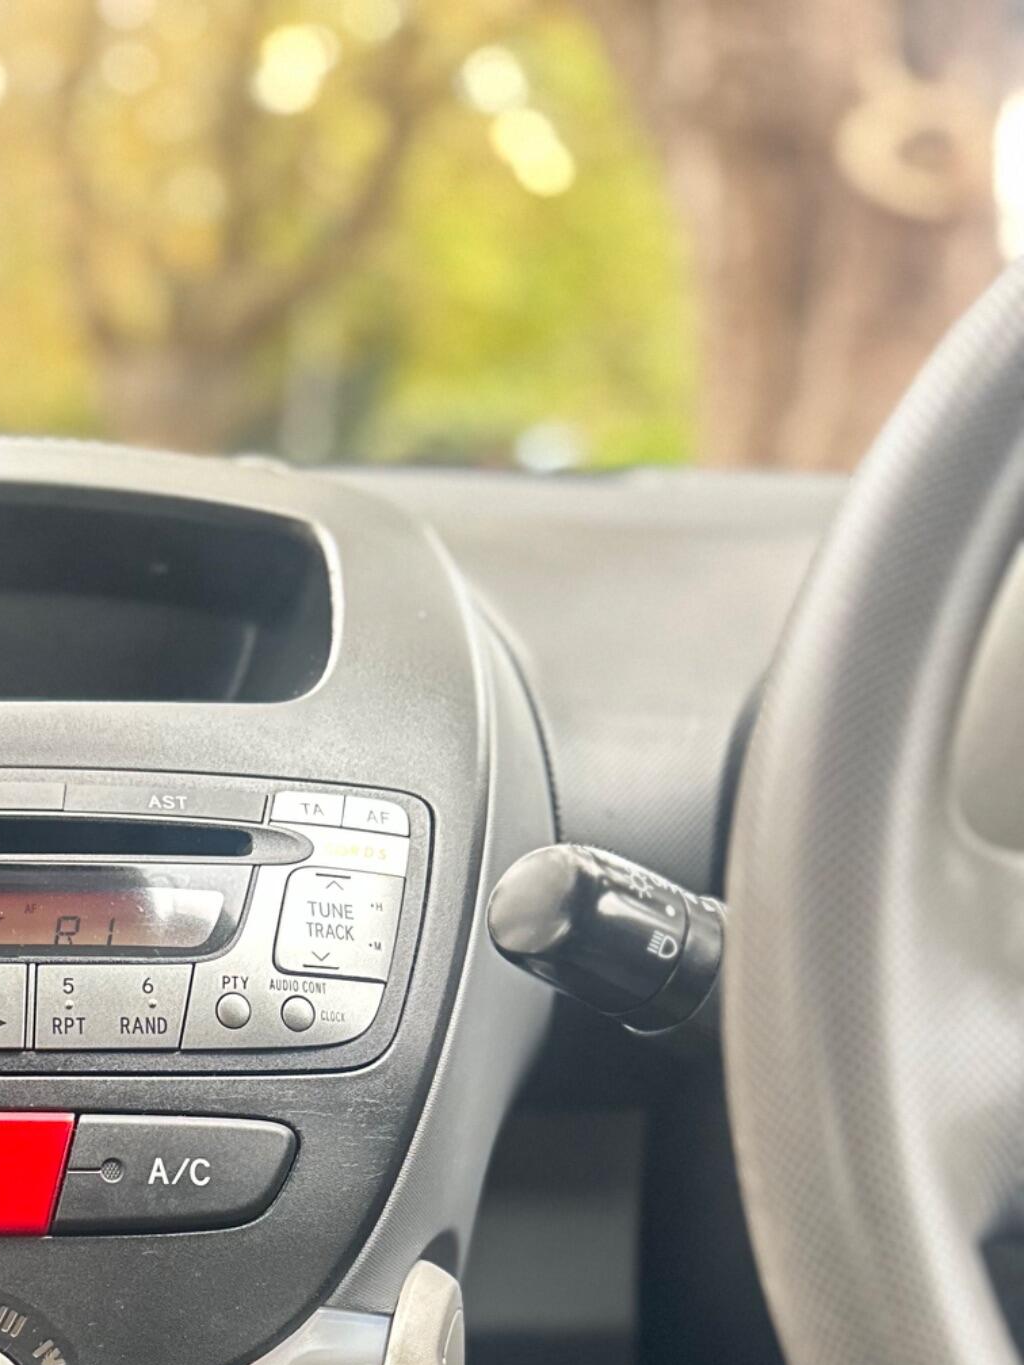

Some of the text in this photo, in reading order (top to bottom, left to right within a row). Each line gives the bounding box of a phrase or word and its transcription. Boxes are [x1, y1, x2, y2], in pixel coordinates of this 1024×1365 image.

[148, 794, 188, 810] AST
[299, 802, 324, 816] TA
[367, 810, 391, 824] AF
[306, 900, 355, 921] TUNE
[305, 921, 355, 941] TRACK
[62, 977, 75, 994] 5
[141, 977, 154, 994] 6
[221, 975, 249, 990] PTY
[269, 978, 327, 994] AUDIO CONT
[320, 1009, 346, 1023] CLOCK
[52, 1016, 86, 1035] RPT
[119, 1016, 168, 1035] RAND
[147, 1157, 211, 1186] A/C
